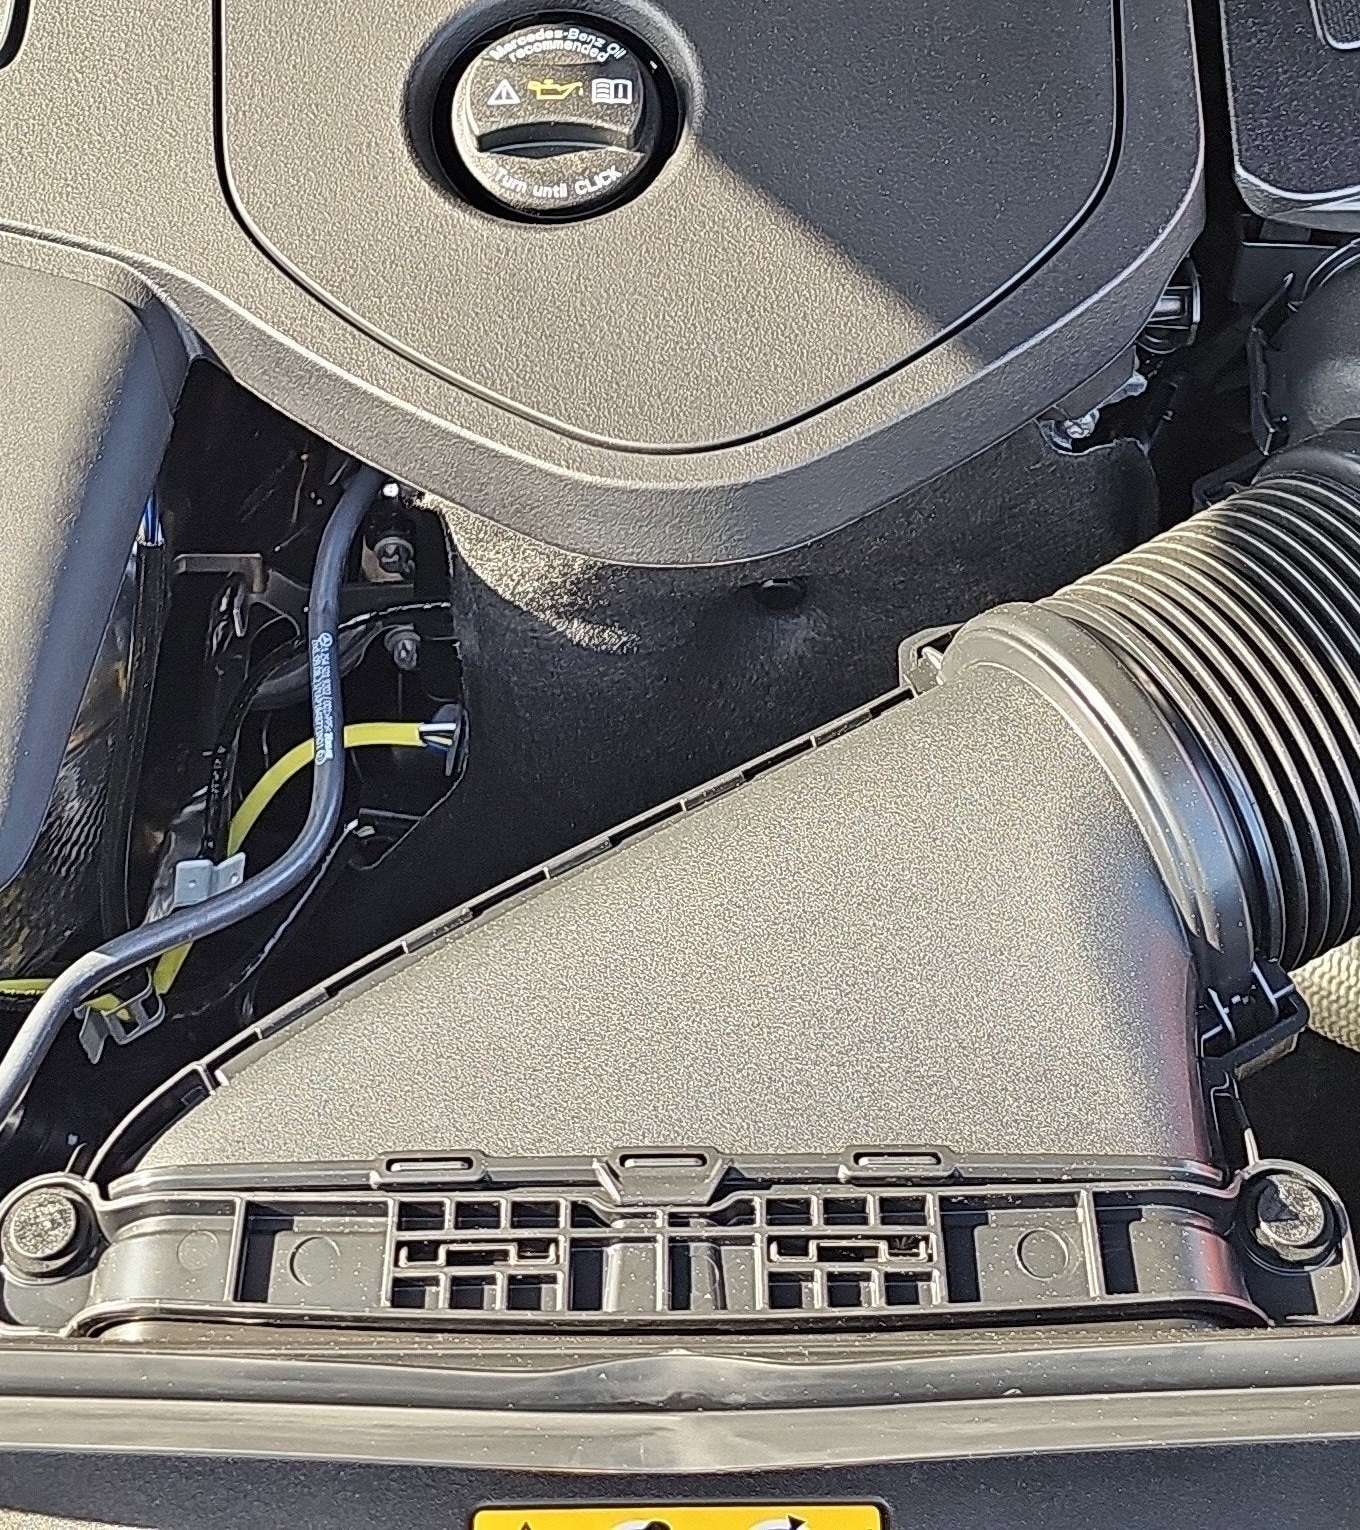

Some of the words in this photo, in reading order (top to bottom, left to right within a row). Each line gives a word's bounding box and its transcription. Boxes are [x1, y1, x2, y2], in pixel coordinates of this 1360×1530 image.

[489, 27, 606, 60] Mercedes-Benz
[606, 42, 627, 60] Oil
[508, 39, 610, 63] recommended
[494, 166, 528, 193] Turn
[532, 182, 568, 199] until
[574, 164, 623, 196] CLICK
